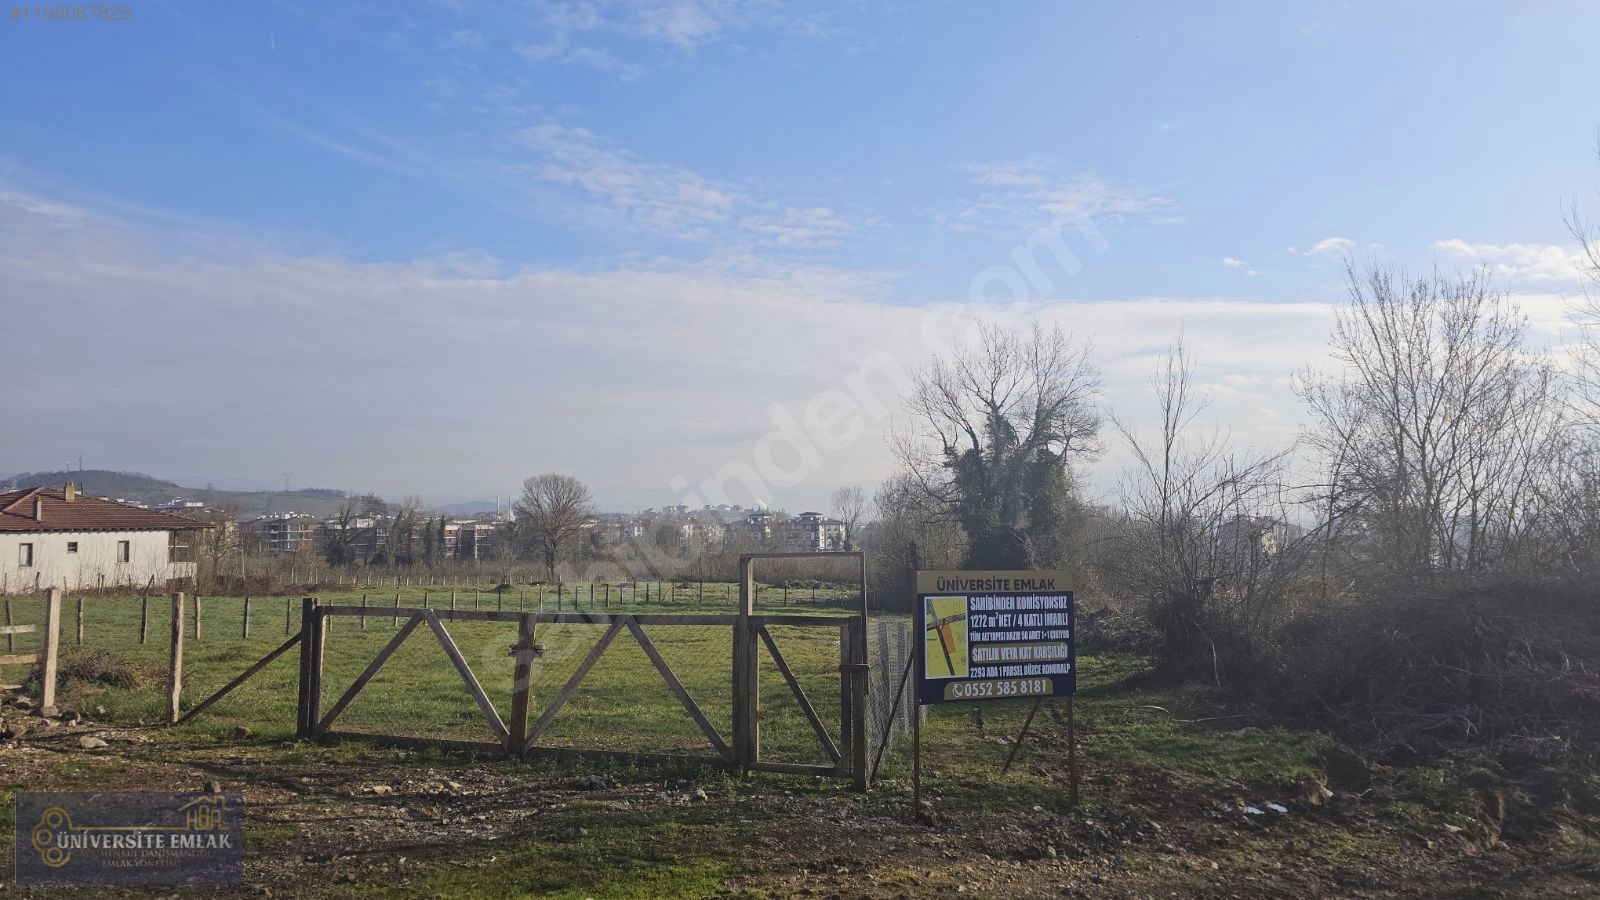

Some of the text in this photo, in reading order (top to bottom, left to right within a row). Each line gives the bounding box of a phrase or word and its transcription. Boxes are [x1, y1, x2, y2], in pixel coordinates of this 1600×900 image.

[936, 576, 1056, 591] ÜNİVERSİTE EMLAK
[970, 614, 987, 628] 1272
[999, 614, 1012, 627] NET
[1017, 613, 1023, 627] 4
[1023, 613, 1043, 626] KATLI
[970, 631, 981, 642] TÜM
[972, 647, 1000, 661] SATILIK
[1001, 646, 1018, 660] VEYA
[1019, 646, 1032, 659] KAT
[970, 667, 986, 678] 2293
[986, 666, 998, 677] ADA
[998, 666, 1003, 677] 1
[1003, 665, 1023, 676] PARSEL
[964, 679, 1047, 697] 0552 585 8181
